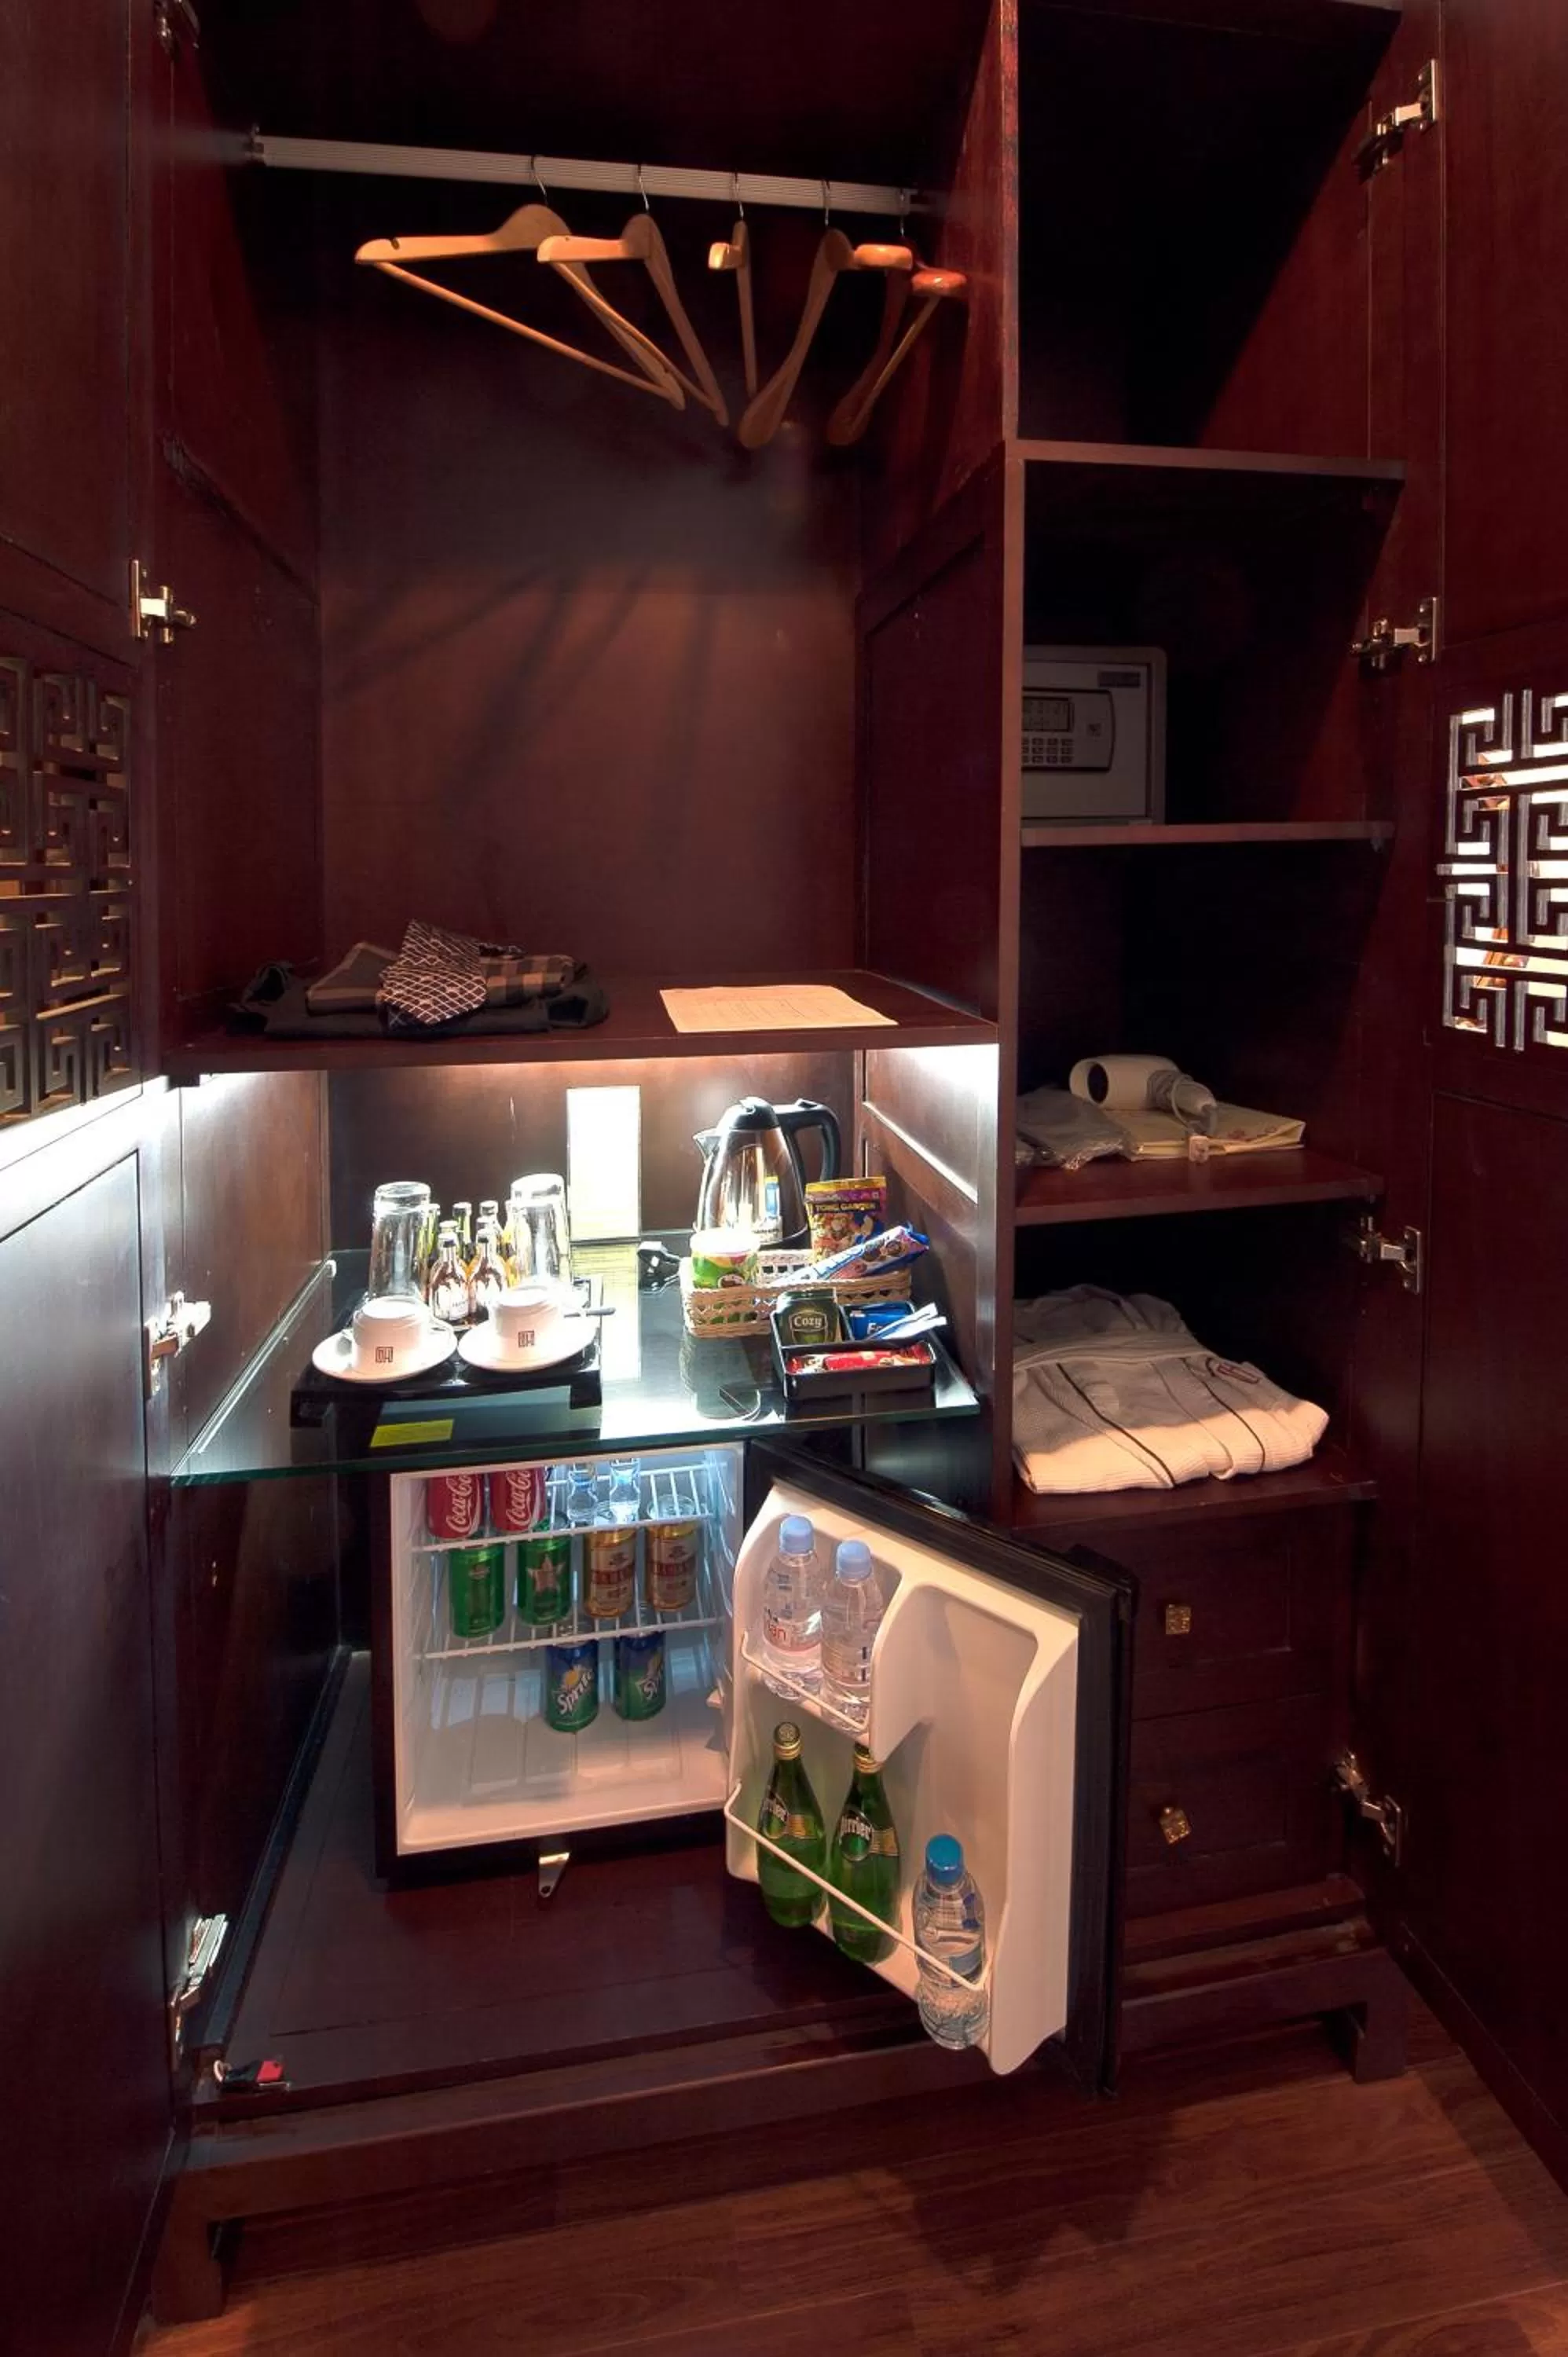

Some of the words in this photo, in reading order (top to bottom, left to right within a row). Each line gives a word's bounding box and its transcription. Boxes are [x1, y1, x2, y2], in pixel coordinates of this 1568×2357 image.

[794, 1316, 822, 1329] Cozy
[445, 1474, 472, 1533] Coca-Co
[505, 1470, 532, 1526] Coca-Co
